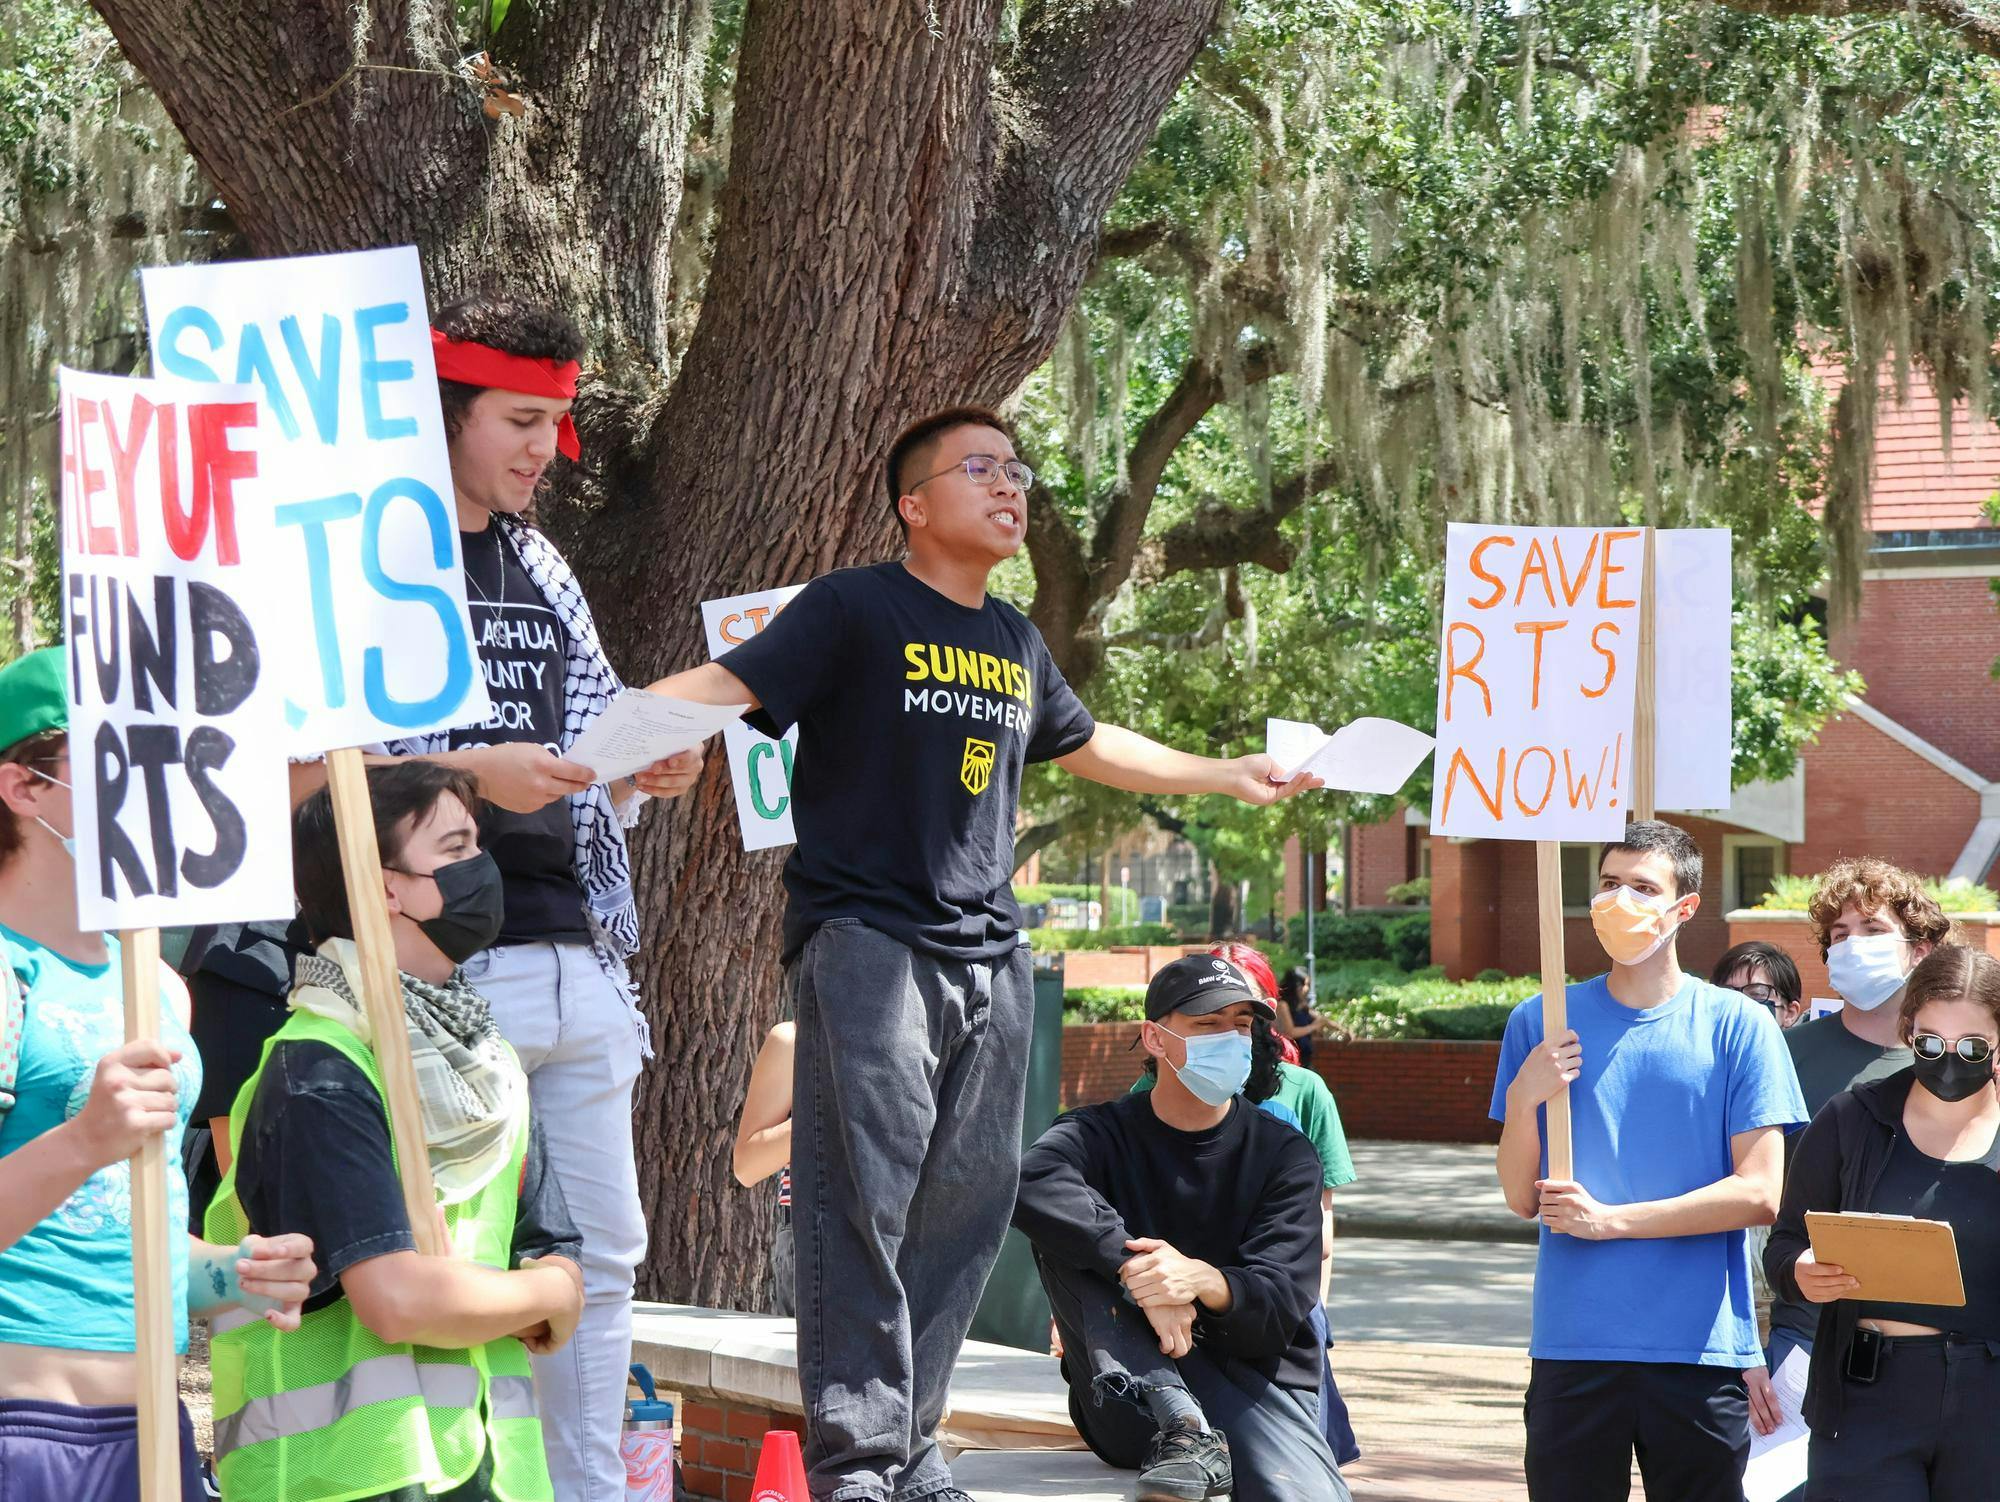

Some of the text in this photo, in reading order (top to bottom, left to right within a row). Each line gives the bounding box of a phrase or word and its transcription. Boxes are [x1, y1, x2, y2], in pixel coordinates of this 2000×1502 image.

[158, 302, 419, 445] SAVE
[275, 477, 473, 730] TS
[475, 619, 558, 652] ACHUA
[1467, 531, 1640, 609] SAVE
[69, 575, 260, 717] FUND
[95, 721, 247, 901] RTS
[1441, 733, 1622, 826] NOW!
